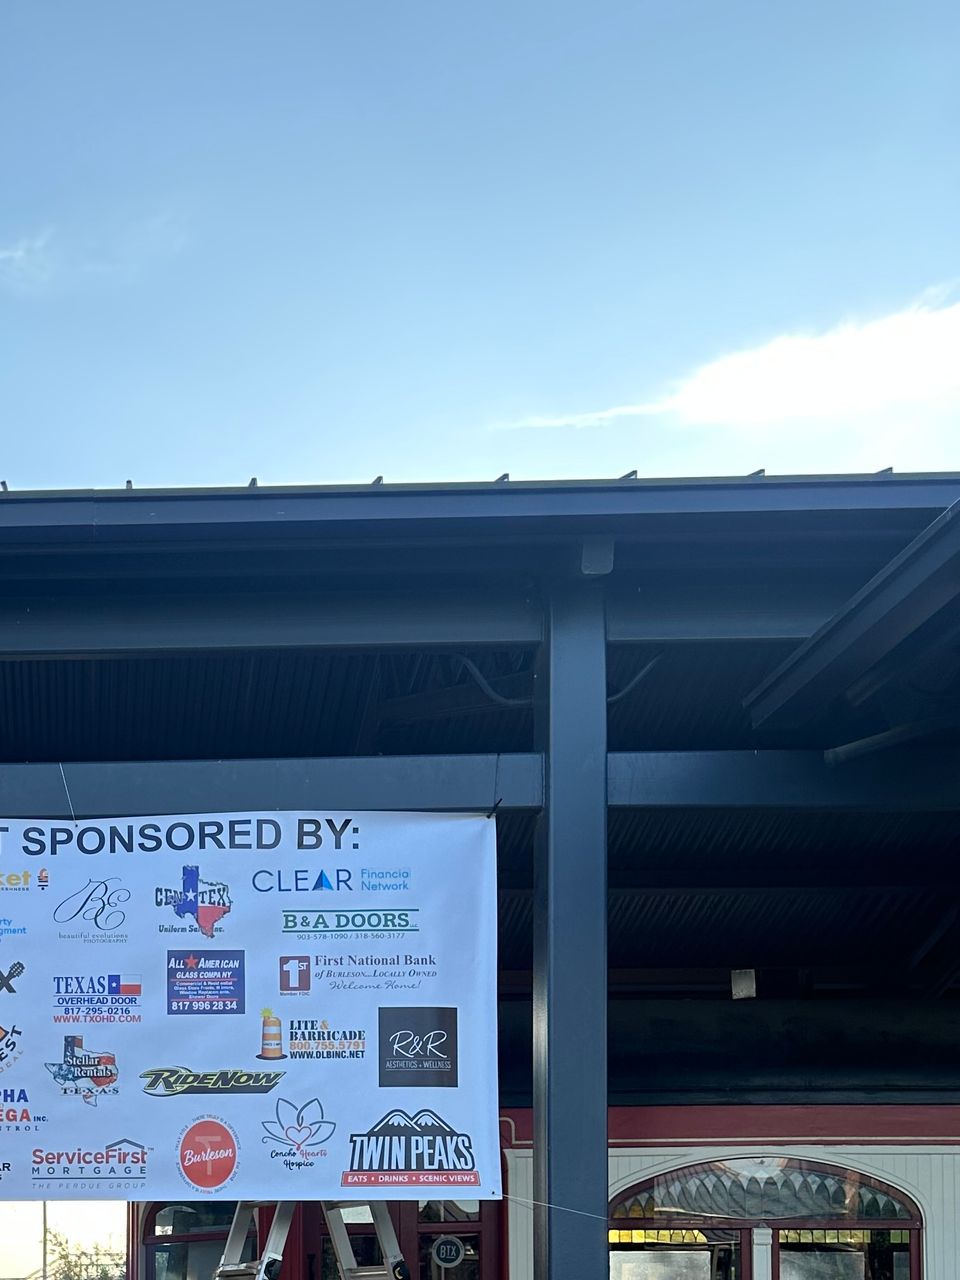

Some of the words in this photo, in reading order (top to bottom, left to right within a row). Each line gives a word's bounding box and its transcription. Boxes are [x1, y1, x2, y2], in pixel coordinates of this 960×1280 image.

[22, 819, 282, 856] SPONSORED
[297, 819, 359, 849] BY:
[252, 869, 353, 892] CLEAR
[361, 881, 409, 891] Network
[335, 913, 409, 929] DOORS
[158, 925, 187, 933] Uniform
[198, 958, 240, 968] AMERICAN
[314, 955, 344, 966] First
[347, 954, 400, 966] National
[404, 954, 437, 966] Bank
[176, 971, 198, 979] GLASS
[314, 969, 325, 979] of
[53, 976, 106, 995] TEXAS
[57, 996, 109, 1005] OVERHEAD
[110, 996, 137, 1005] DOOR
[171, 1001, 190, 1010] 817
[192, 1001, 211, 1010] 996
[63, 1007, 131, 1015] 817-295-0216
[53, 1015, 141, 1023] WWW.TXOHD.COM
[290, 1020, 318, 1030] LITE
[290, 1030, 366, 1041] BARRICADE
[290, 1041, 365, 1050] 800.755.5791
[66, 1055, 100, 1066] Stellar
[385, 1061, 418, 1069] AESTHETICS
[423, 1061, 452, 1069] WELLNESS
[73, 1066, 112, 1078] Rentals
[32, 1149, 147, 1165] ServiceFirst
[184, 1148, 234, 1167] Burleson
[299, 1149, 327, 1159] Hearts
[352, 1136, 406, 1170] TWIN
[411, 1135, 473, 1170] PEAKS
[32, 1166, 146, 1175] MORTGAGE
[284, 1160, 315, 1171] Hospice
[440, 1245, 457, 1258] BTX
